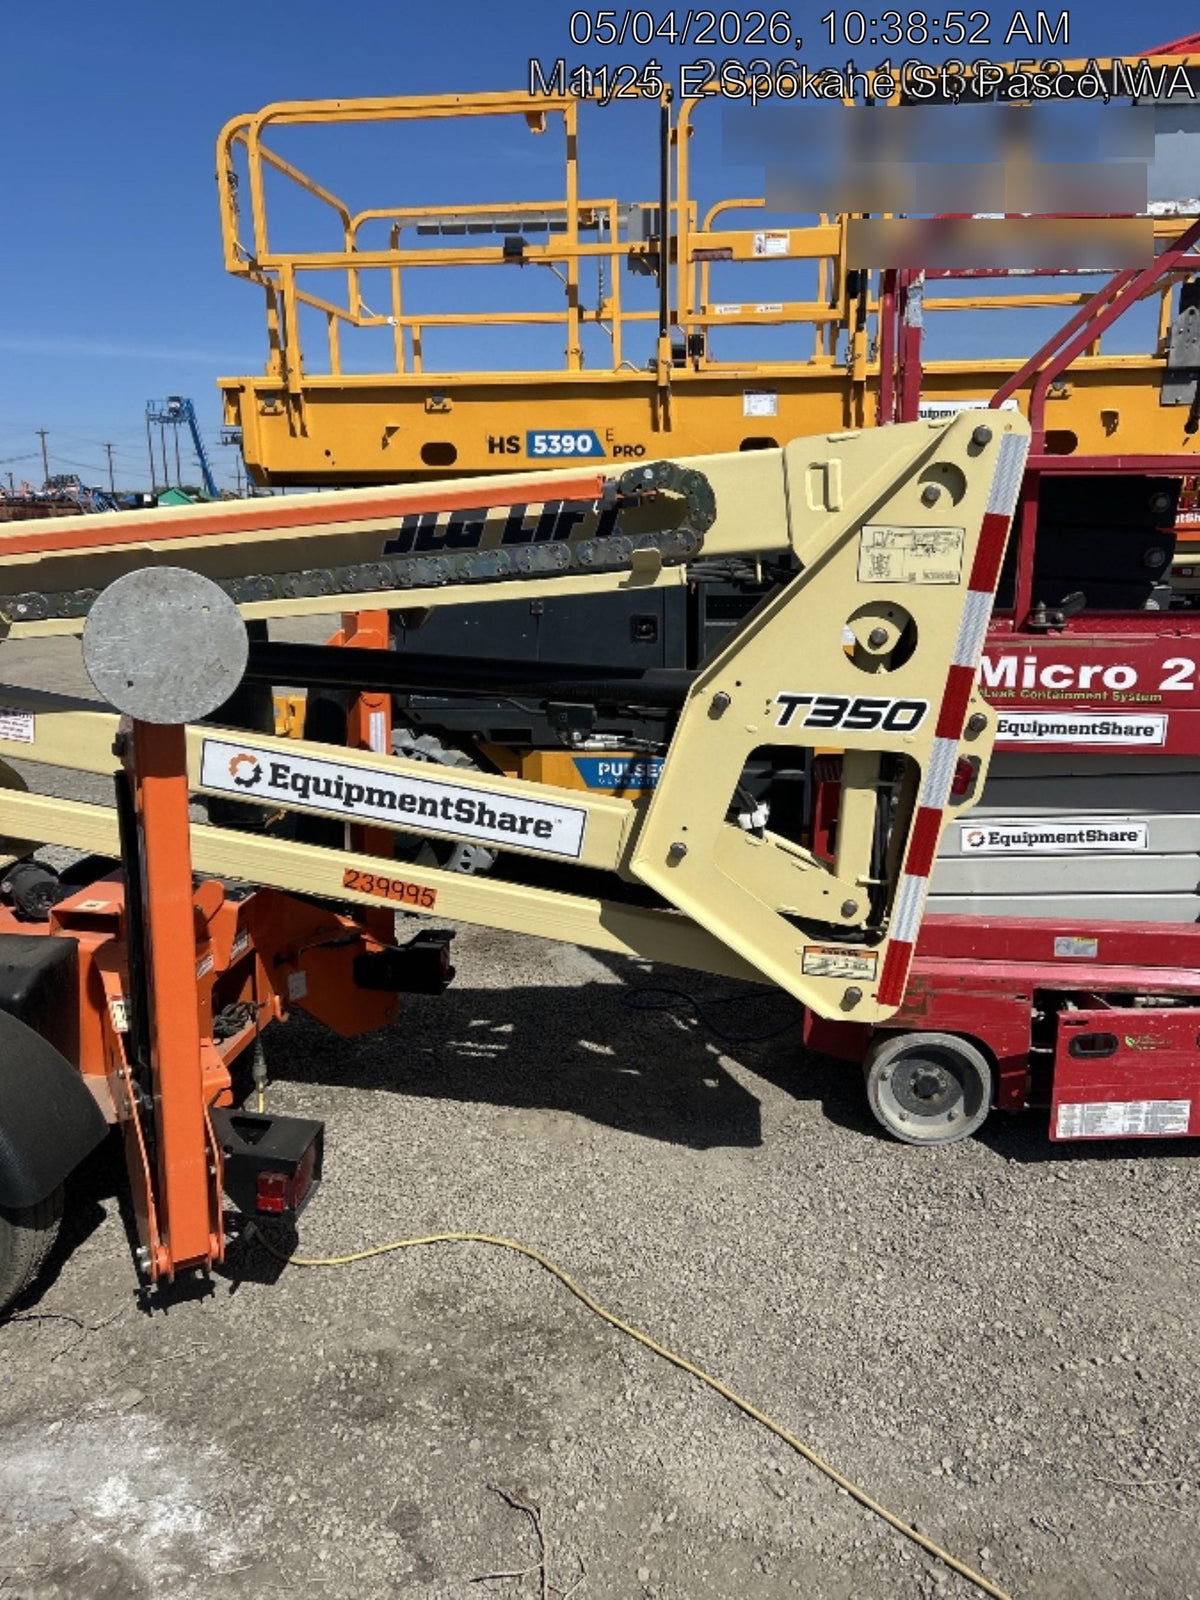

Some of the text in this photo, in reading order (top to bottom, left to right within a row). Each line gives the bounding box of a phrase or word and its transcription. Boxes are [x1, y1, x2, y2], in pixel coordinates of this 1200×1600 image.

[488, 428, 646, 457] HS 5390 E PRO
[383, 498, 620, 555] JLG LIFT
[979, 655, 1200, 690] Micro 2
[776, 693, 929, 732] T350
[997, 719, 1155, 738] EquipmentShare
[267, 762, 554, 839] EquipmentShare
[988, 829, 1138, 848] EquipmentShare
[344, 869, 435, 907] 239995
